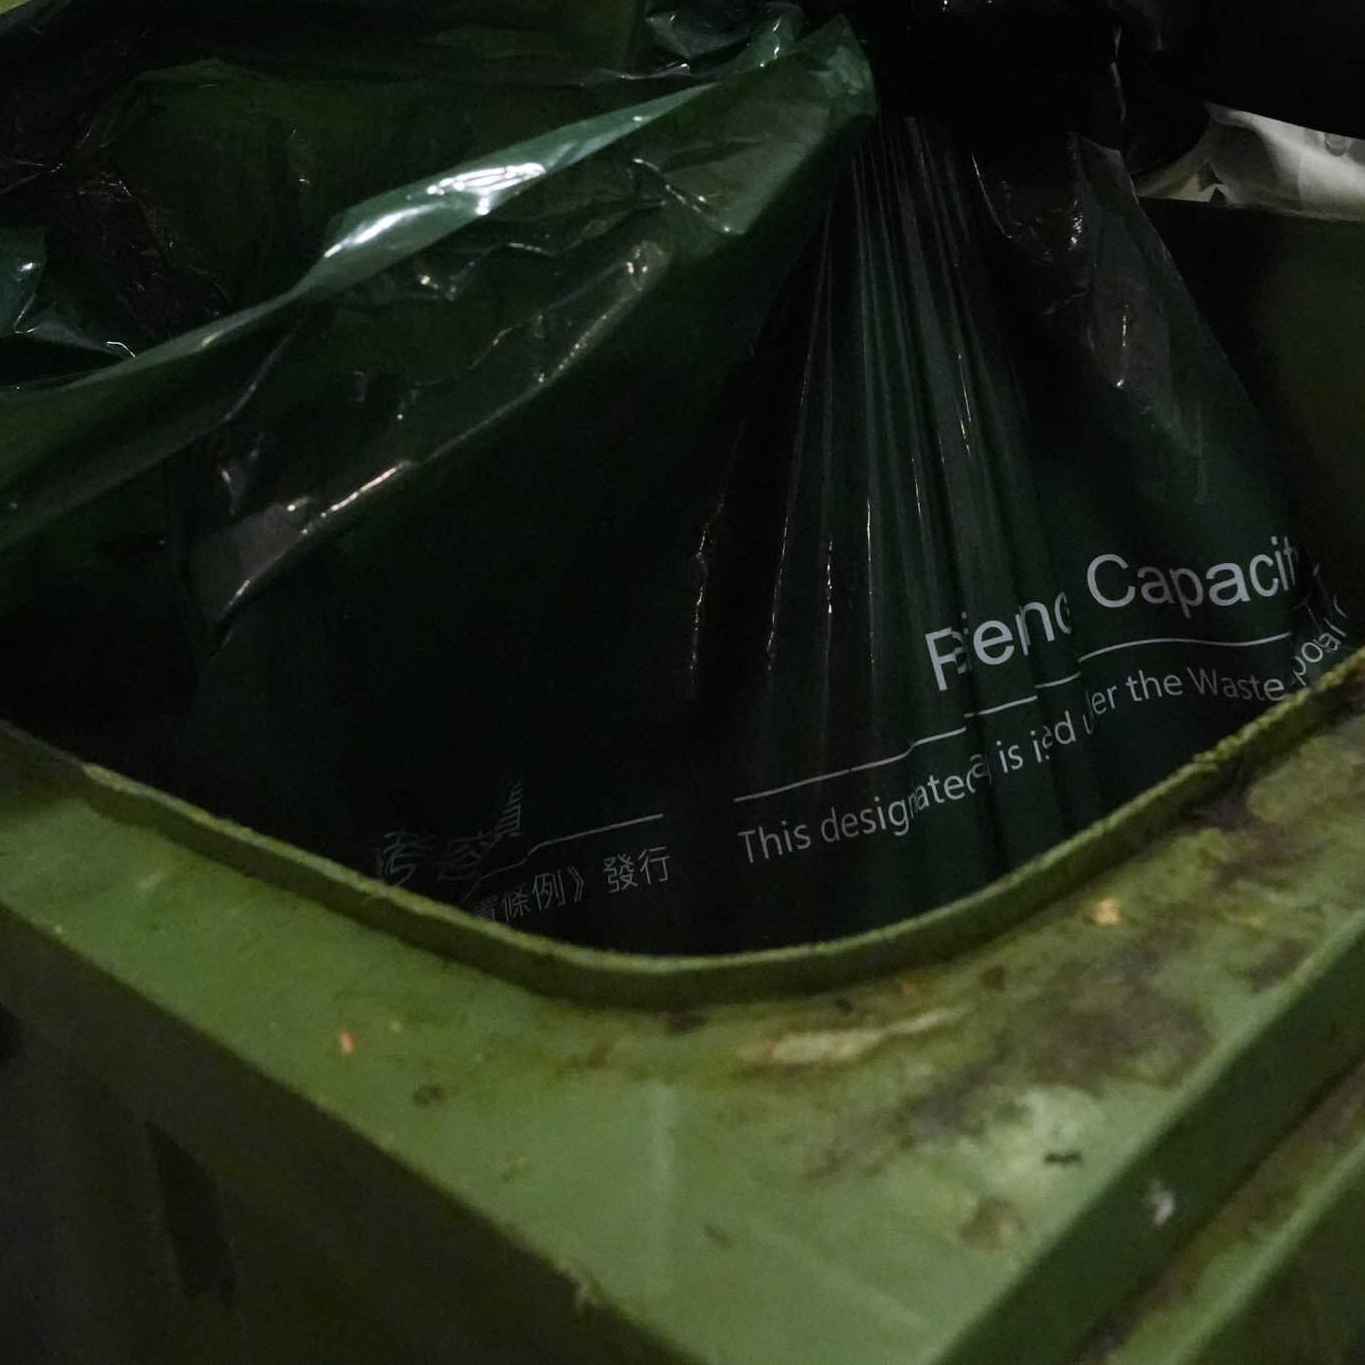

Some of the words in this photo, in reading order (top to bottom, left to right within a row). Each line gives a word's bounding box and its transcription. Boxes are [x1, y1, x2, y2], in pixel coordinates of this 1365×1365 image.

[1086, 535, 1300, 619] Capacit
[737, 820, 812, 865] This
[995, 739, 1025, 775] is
[1125, 668, 1184, 703] the
[1186, 665, 1286, 703] Waste
[602, 846, 672, 894] 發行
